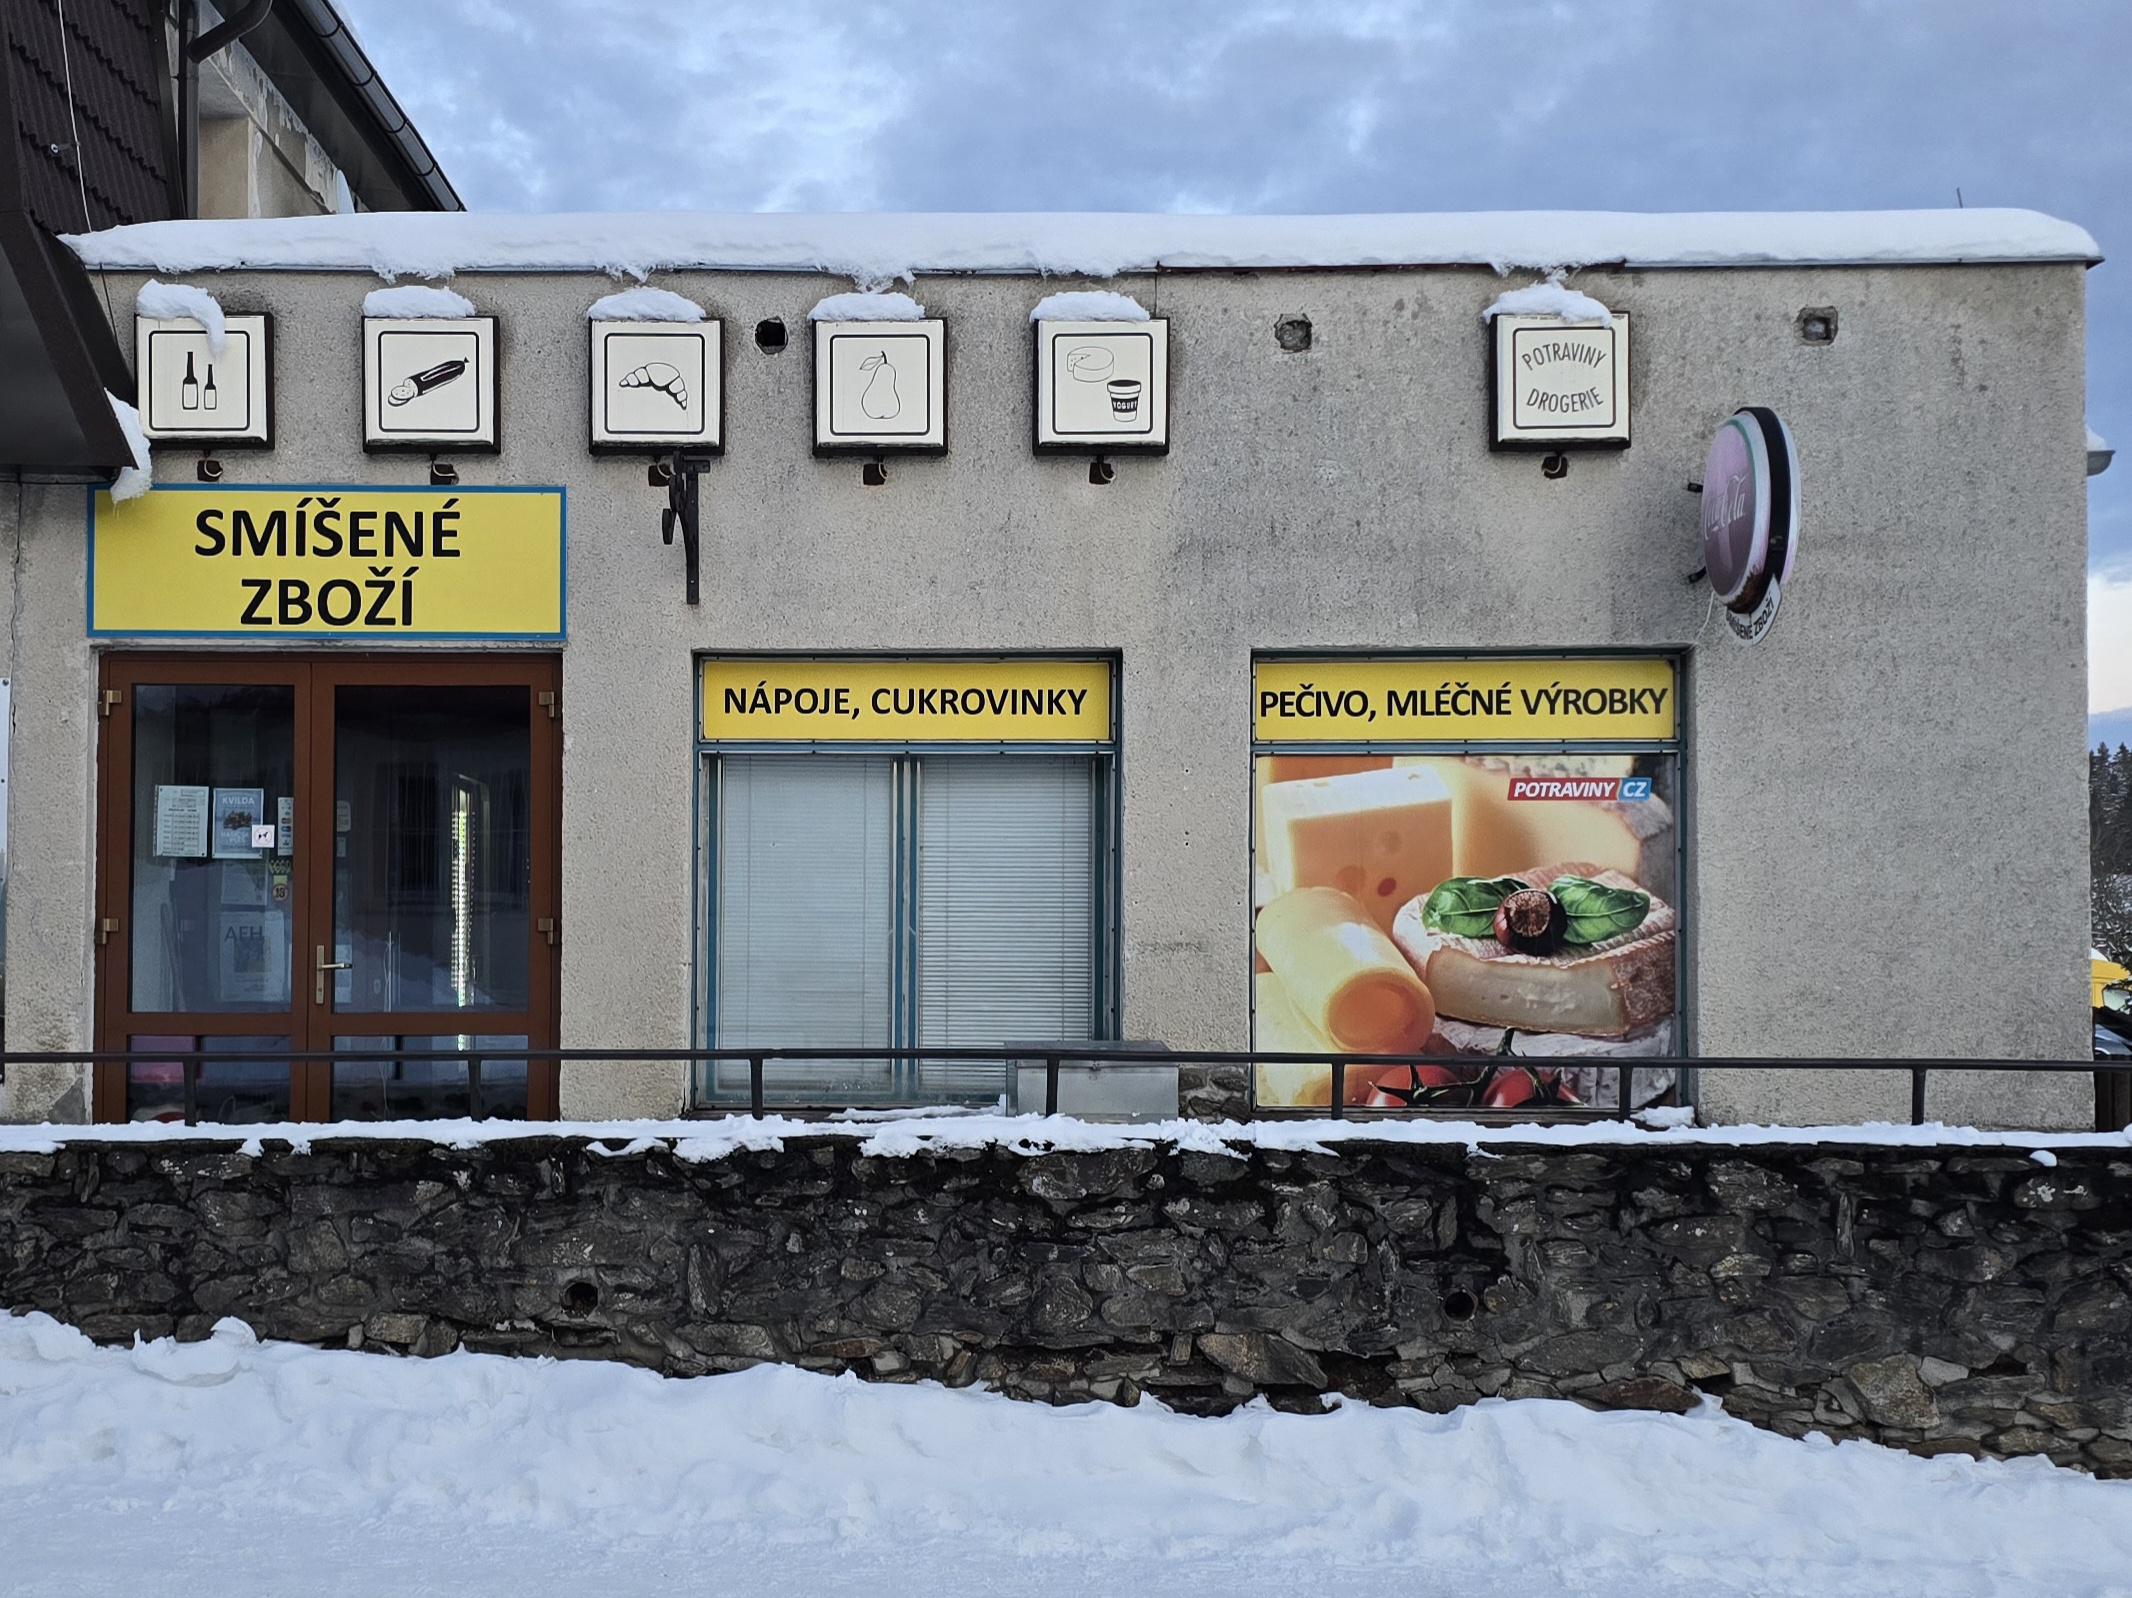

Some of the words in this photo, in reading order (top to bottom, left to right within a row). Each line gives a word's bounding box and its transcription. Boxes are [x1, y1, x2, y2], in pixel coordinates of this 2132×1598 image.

[1521, 342, 1607, 371] POTRAVINY
[1526, 386, 1604, 413] DROGERIE
[195, 497, 461, 557] SMÍŠENÉ
[240, 566, 420, 627] ZBOŽÍ
[724, 680, 860, 720] NÁPOJE,
[871, 688, 1088, 716] CUKROVINKY
[1260, 683, 1377, 722] PEČIVO,
[1387, 682, 1512, 716] MLÉČNÉ
[1521, 682, 1669, 716] VÝROBKY
[1513, 782, 1616, 798] POTRAVINY
[1622, 782, 1648, 798] CZ
